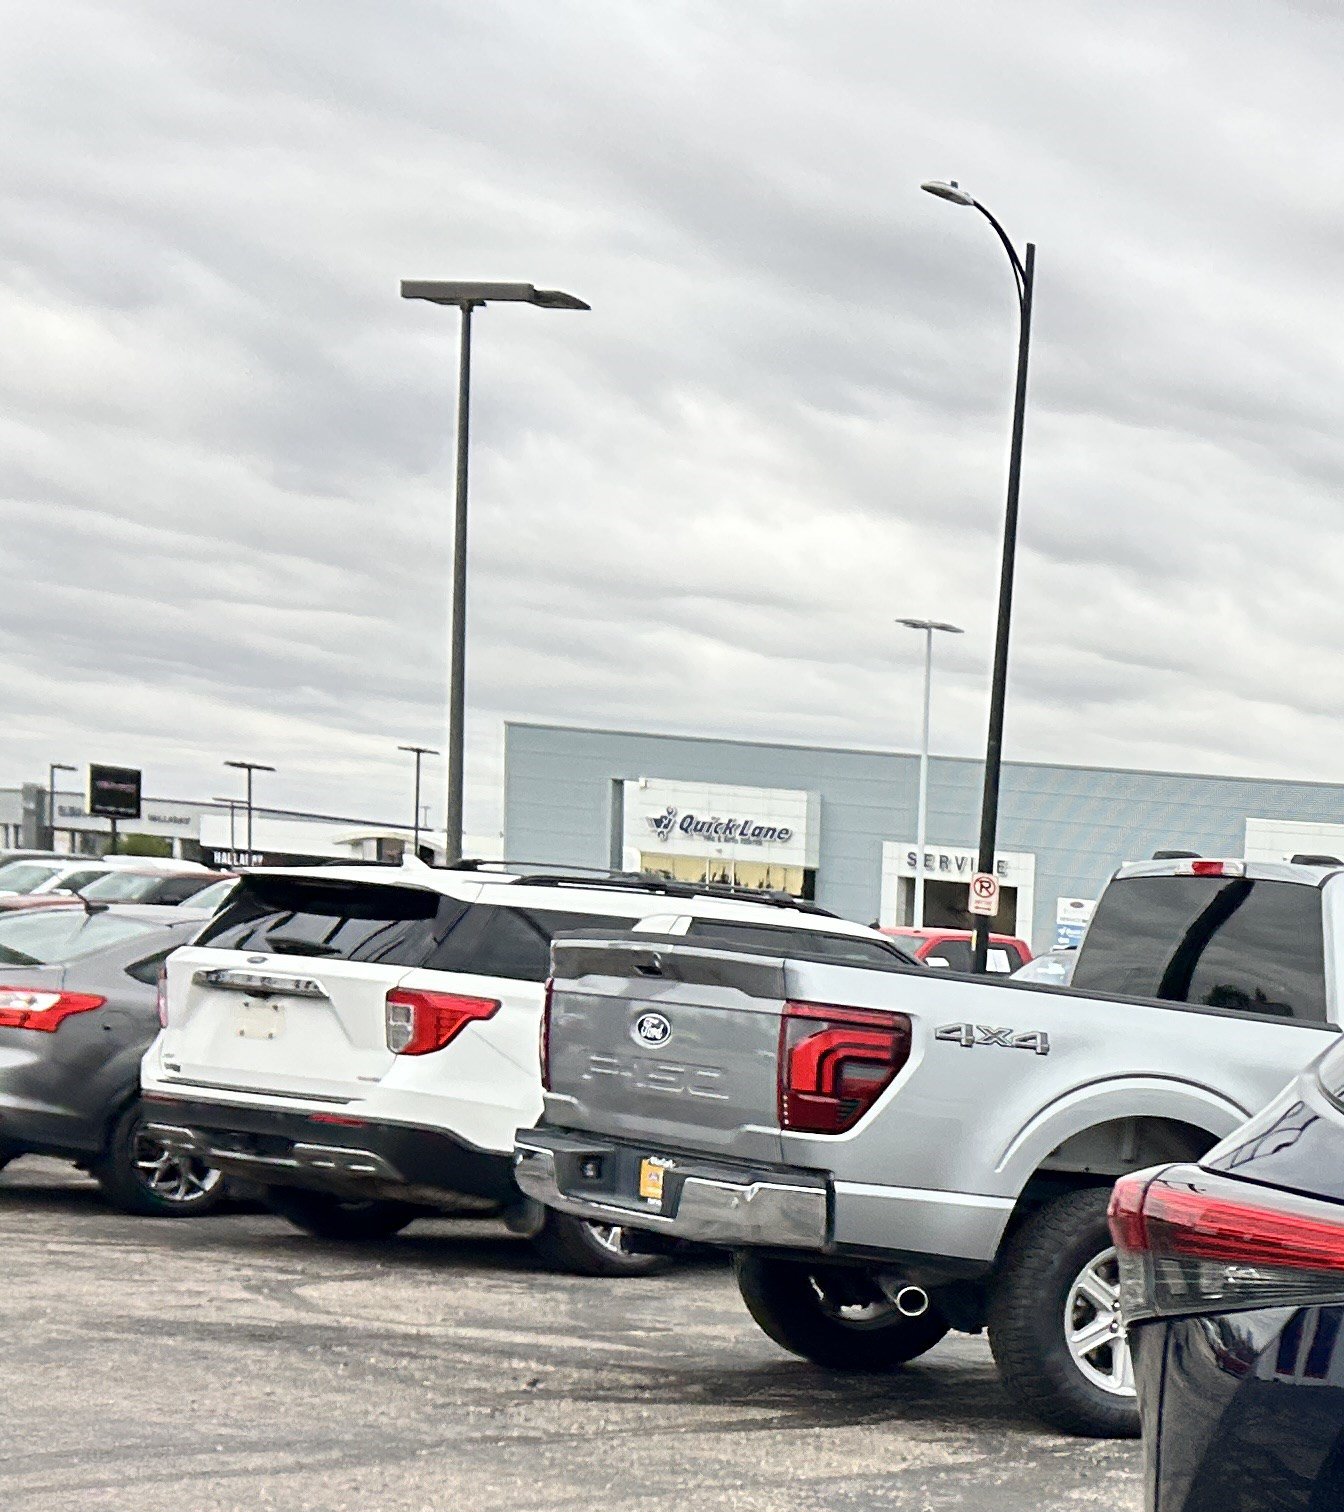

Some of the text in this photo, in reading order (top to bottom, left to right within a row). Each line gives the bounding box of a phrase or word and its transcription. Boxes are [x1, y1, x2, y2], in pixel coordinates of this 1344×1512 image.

[679, 814, 737, 836] Quick
[738, 819, 792, 840] Lane
[907, 851, 1008, 878] SERVIE
